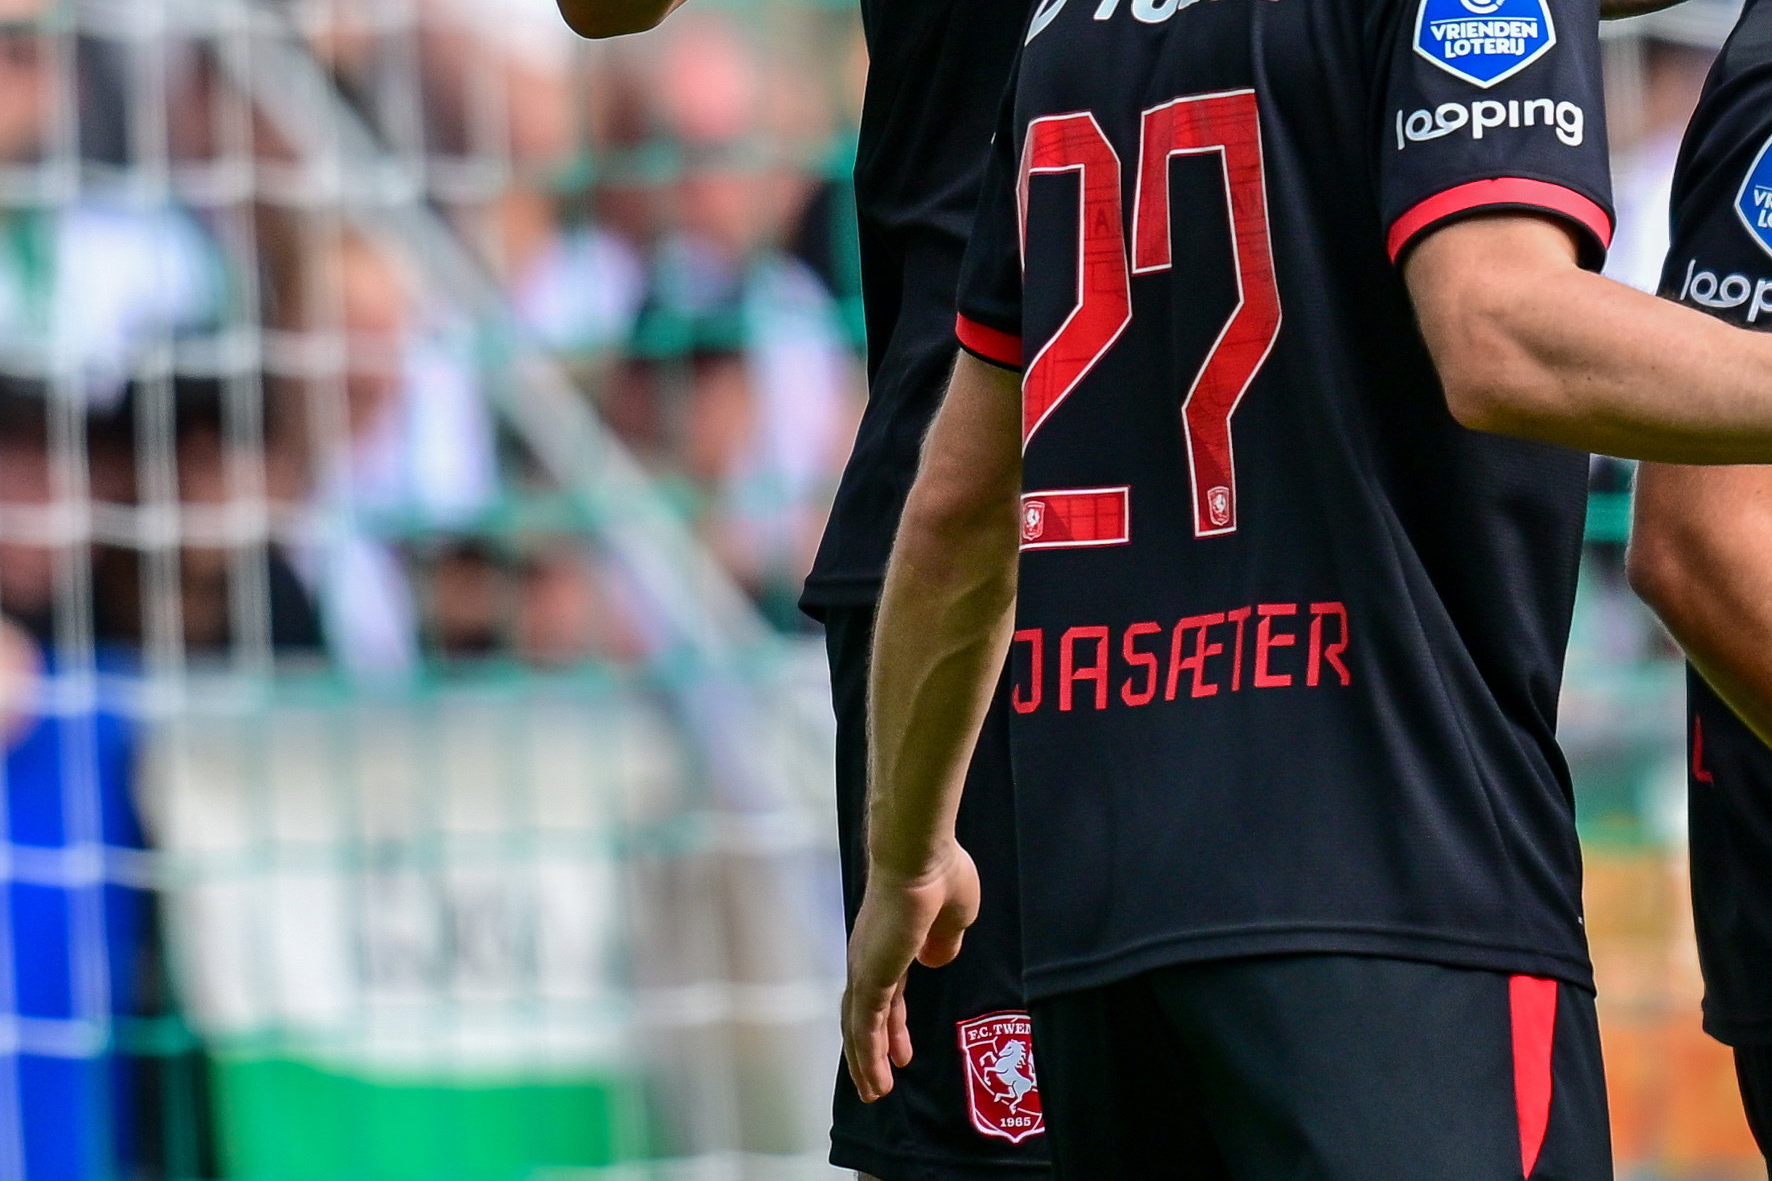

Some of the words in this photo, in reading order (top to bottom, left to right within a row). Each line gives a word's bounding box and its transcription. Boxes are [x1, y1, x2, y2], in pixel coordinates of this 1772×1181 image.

[1430, 21, 1538, 41] VRIENDEN
[1444, 38, 1526, 59] LOTERIJ
[1395, 97, 1584, 151] looping
[1015, 87, 1283, 551] 27
[993, 1022, 1032, 1036] TWEN
